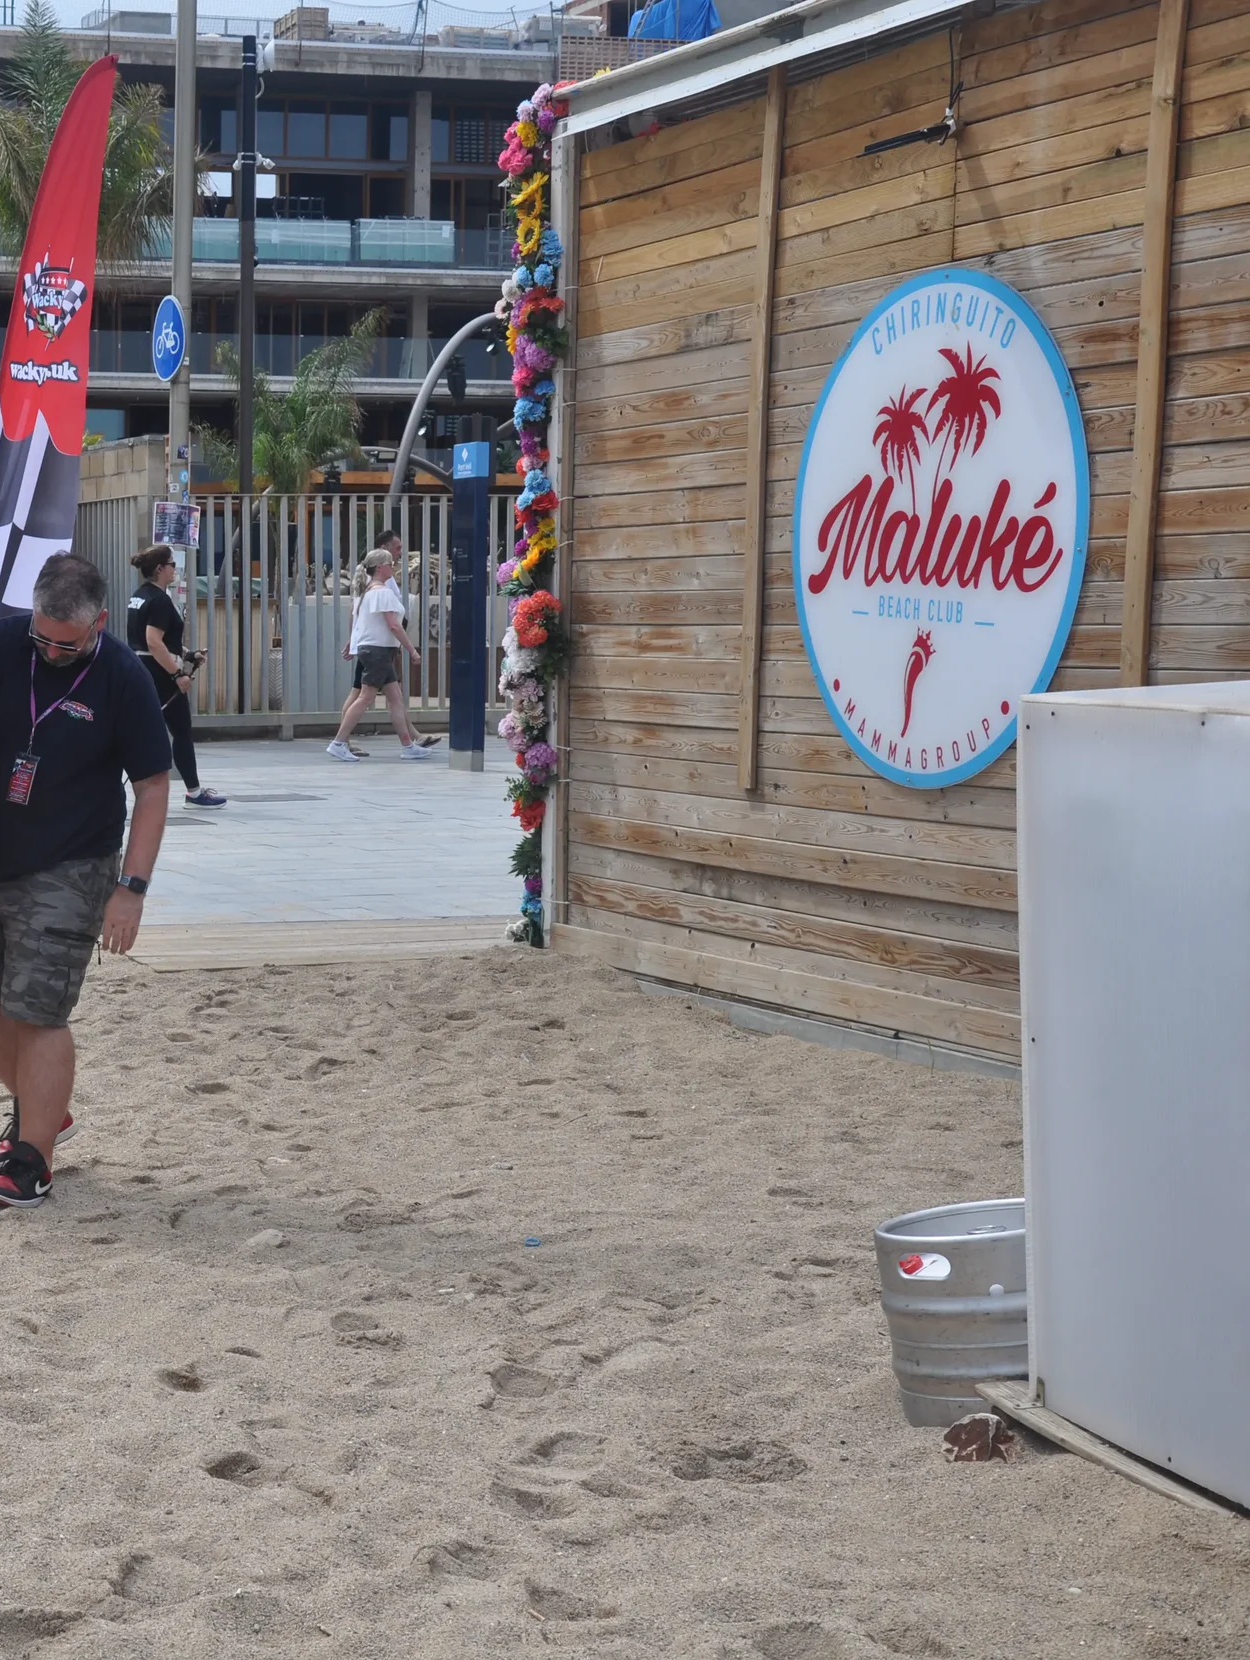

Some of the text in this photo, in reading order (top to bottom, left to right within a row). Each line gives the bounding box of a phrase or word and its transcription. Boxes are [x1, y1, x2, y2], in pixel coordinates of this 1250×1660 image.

[872, 292, 1017, 355] CHIRINGUITO
[808, 474, 1064, 594] Maluké
[878, 595, 964, 624] BEACH CLUB
[844, 698, 990, 770] MAMMAGROUP
